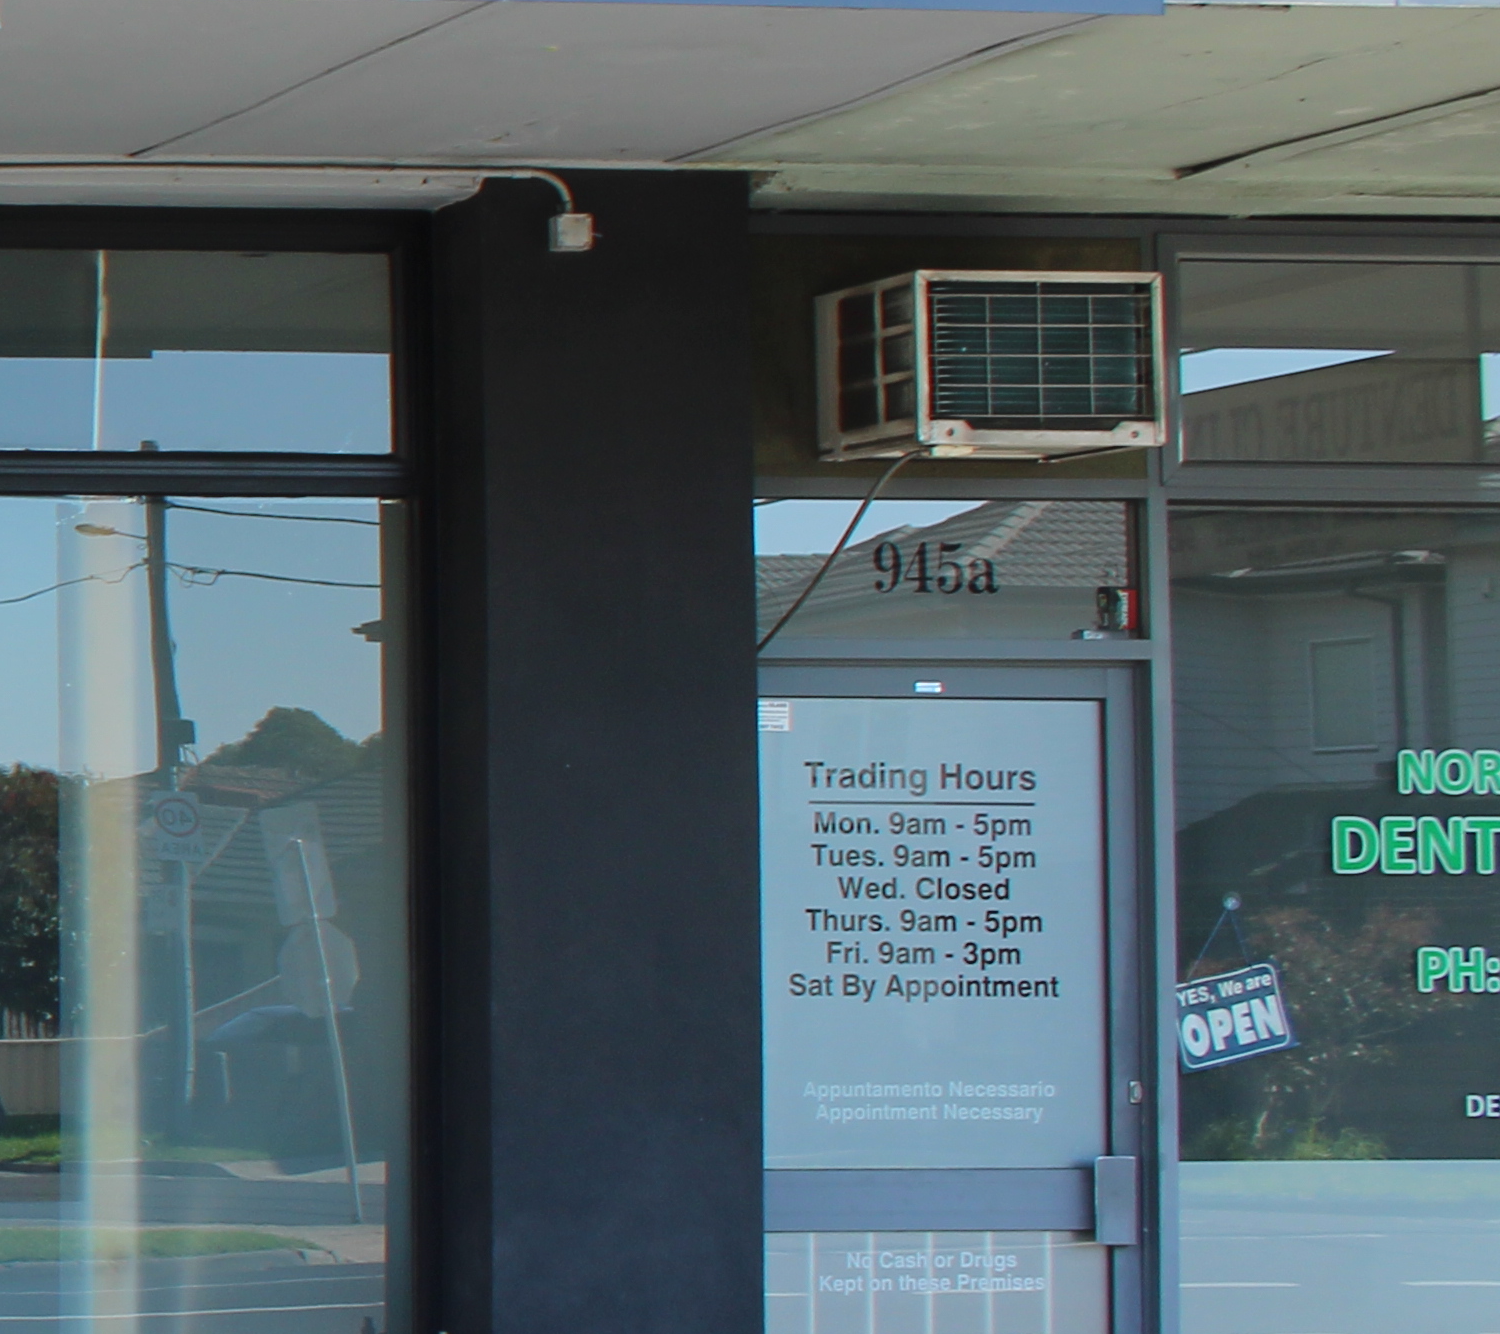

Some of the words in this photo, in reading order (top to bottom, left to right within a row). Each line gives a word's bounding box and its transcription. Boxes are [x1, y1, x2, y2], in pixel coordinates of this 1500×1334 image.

[872, 541, 999, 596] 945a
[804, 762, 926, 797] Trading
[940, 764, 1036, 792] Hours
[813, 812, 880, 836] Mon.
[888, 813, 946, 836] 9am
[973, 814, 1032, 841] 5pm
[810, 845, 885, 869] Tues.
[893, 845, 951, 869] 9am
[978, 847, 1036, 873] 5pm
[837, 877, 906, 901] Wed.
[915, 877, 1010, 901] Closed
[805, 909, 891, 934] Thurs.
[899, 910, 957, 934] 9am
[984, 911, 1043, 938] 5pm
[825, 942, 870, 965] Fri.
[877, 942, 936, 965] 9am
[962, 943, 1021, 970] 3pm
[789, 974, 833, 997] Sat
[842, 974, 877, 1003] By
[884, 974, 1060, 1003] Appointment
[1217, 980, 1243, 997] We
[1246, 974, 1271, 990] are
[1182, 994, 1285, 1057] OPEN
[803, 1081, 942, 1102] Appuntamento
[949, 1080, 1056, 1097] Necessario
[816, 1104, 937, 1124] Appointment
[944, 1104, 1044, 1124] Necessary
[846, 1252, 871, 1268] No
[880, 1251, 927, 1268] Cash
[935, 1254, 954, 1268] or
[961, 1251, 1018, 1272] Drugs
[819, 1275, 863, 1295] Kept
[871, 1278, 892, 1291] on
[899, 1275, 951, 1291] these
[957, 1274, 1045, 1291] Premises
